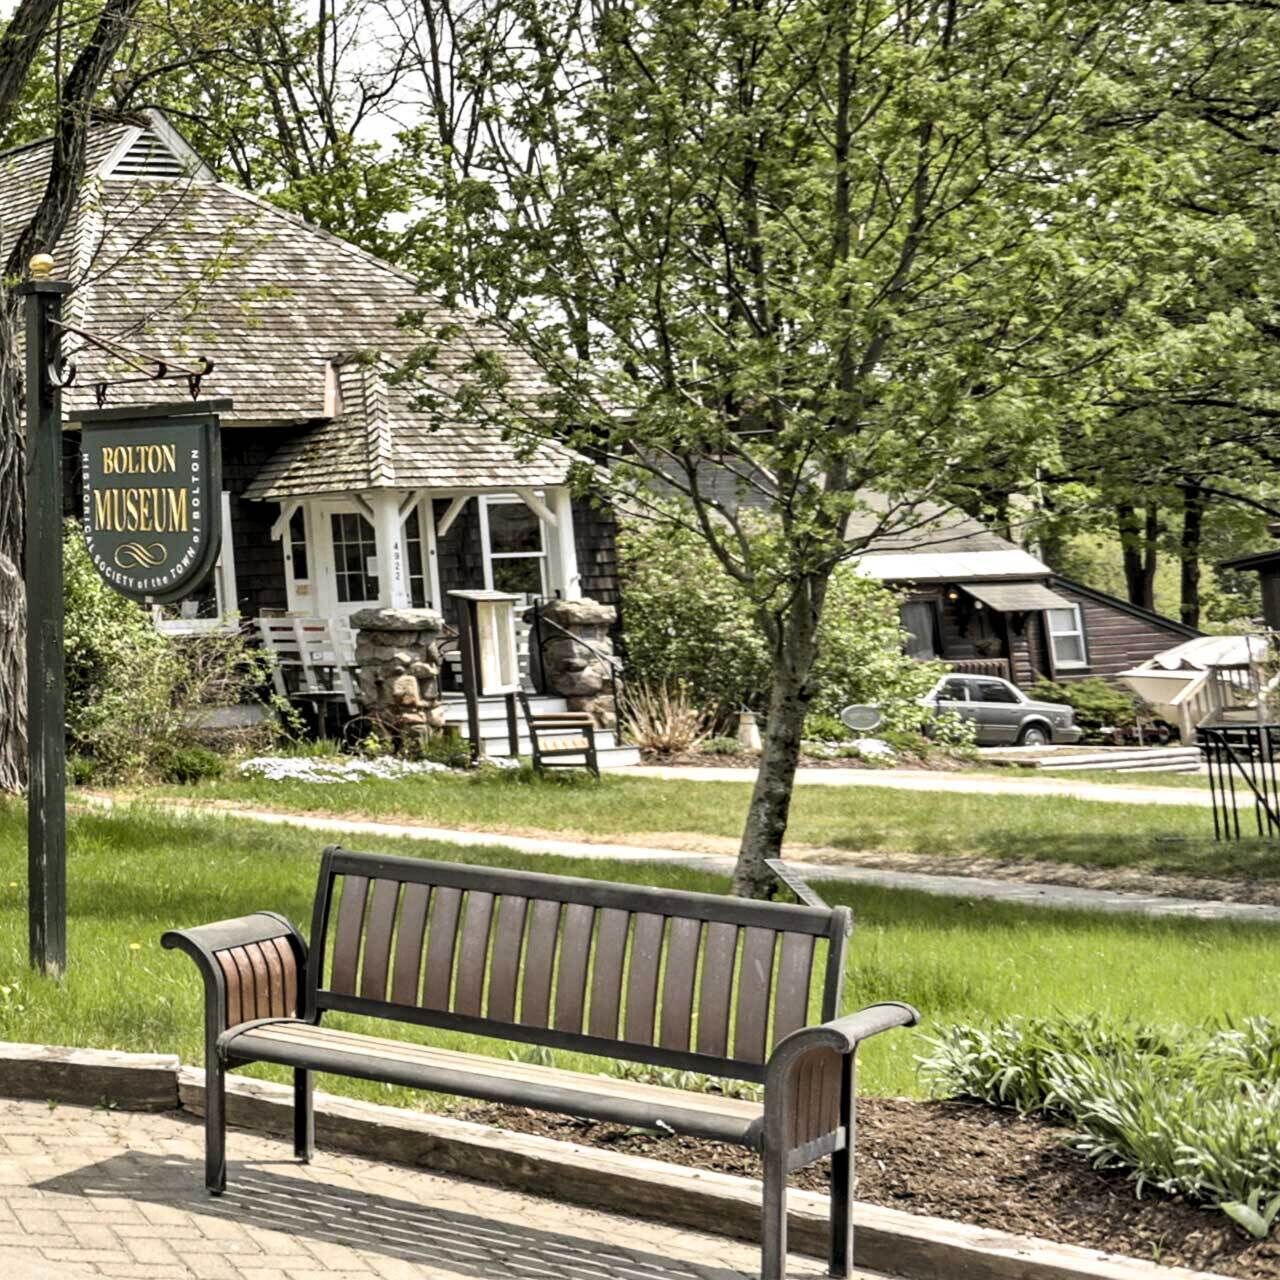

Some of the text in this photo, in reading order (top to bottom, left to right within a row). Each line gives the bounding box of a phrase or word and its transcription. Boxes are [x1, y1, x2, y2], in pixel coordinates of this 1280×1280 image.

[102, 443, 177, 475] BOLTON
[82, 453, 95, 553] HISTORICAL
[94, 554, 135, 588] SOCIETY
[169, 546, 197, 579] TOWN
[191, 449, 201, 520] BOLTON
[93, 486, 189, 533] MUSEUM
